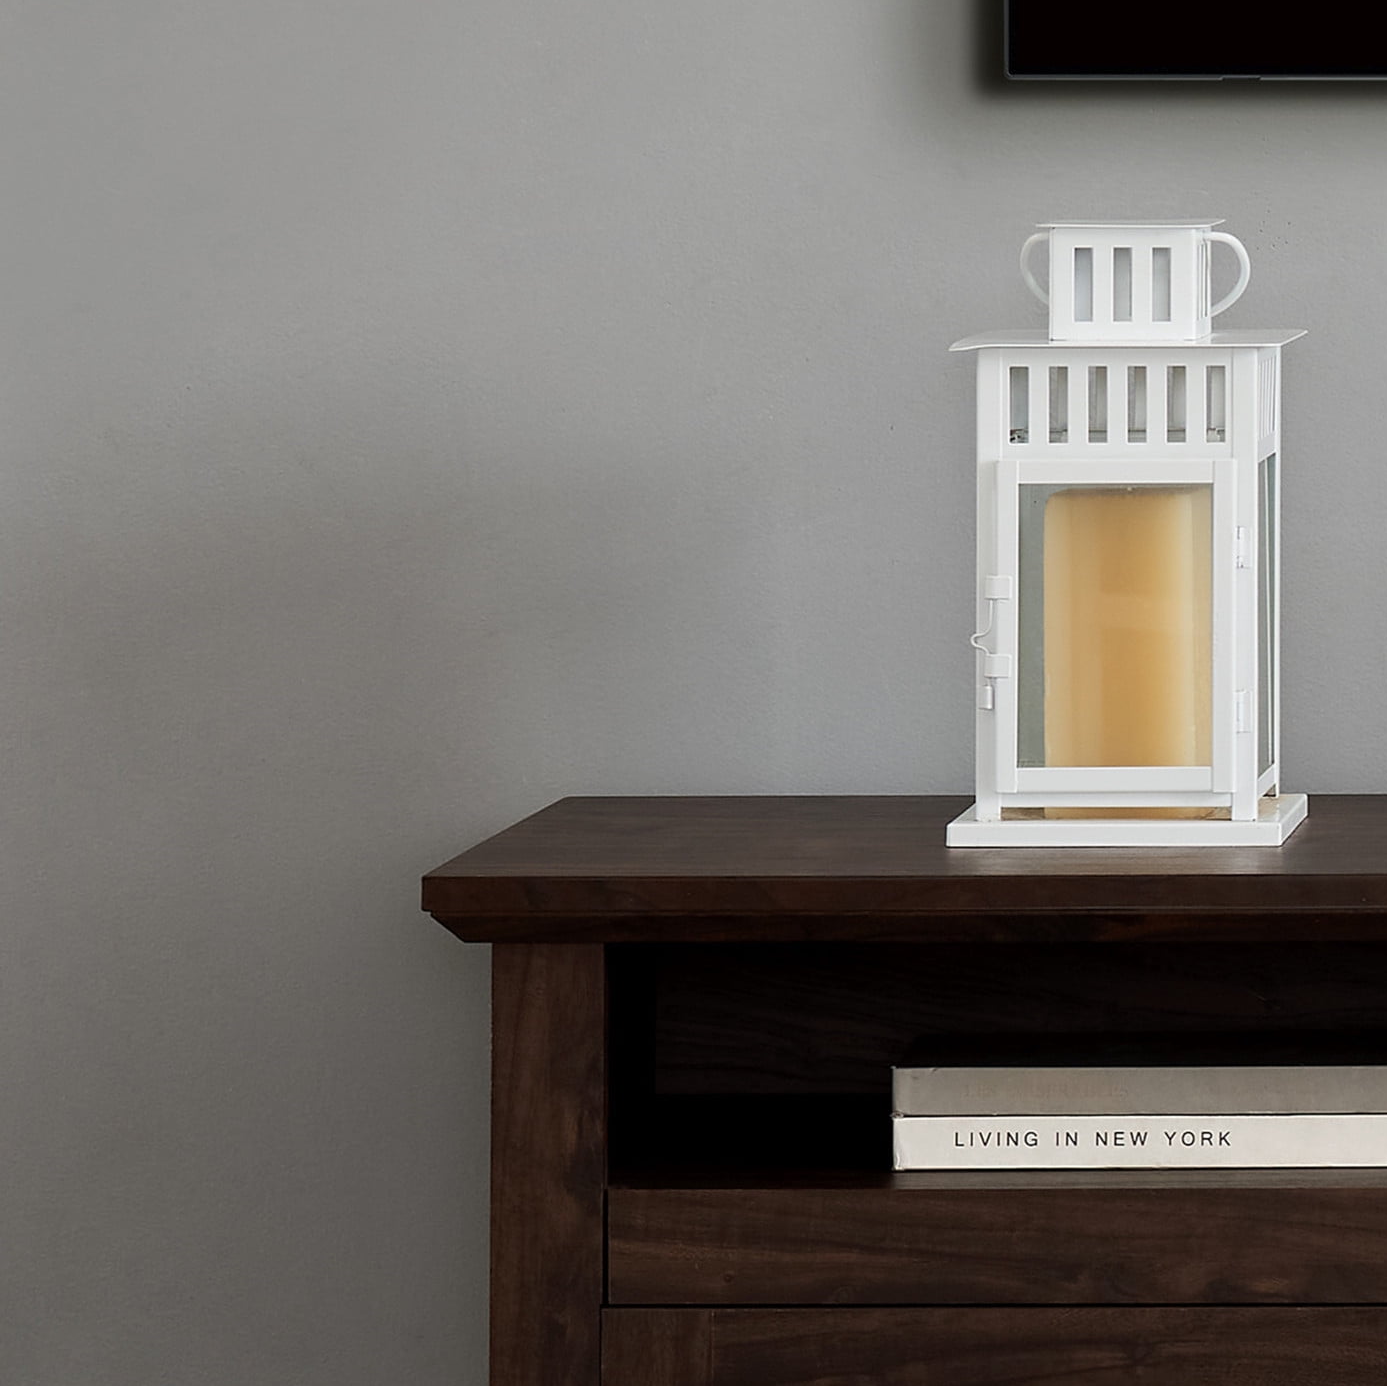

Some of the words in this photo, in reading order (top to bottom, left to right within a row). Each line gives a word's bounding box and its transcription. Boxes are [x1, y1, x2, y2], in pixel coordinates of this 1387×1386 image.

[954, 1131, 1038, 1147] LIVING
[1055, 1131, 1078, 1147] IN
[1095, 1131, 1148, 1147] NEW
[1164, 1131, 1232, 1147] YORK
